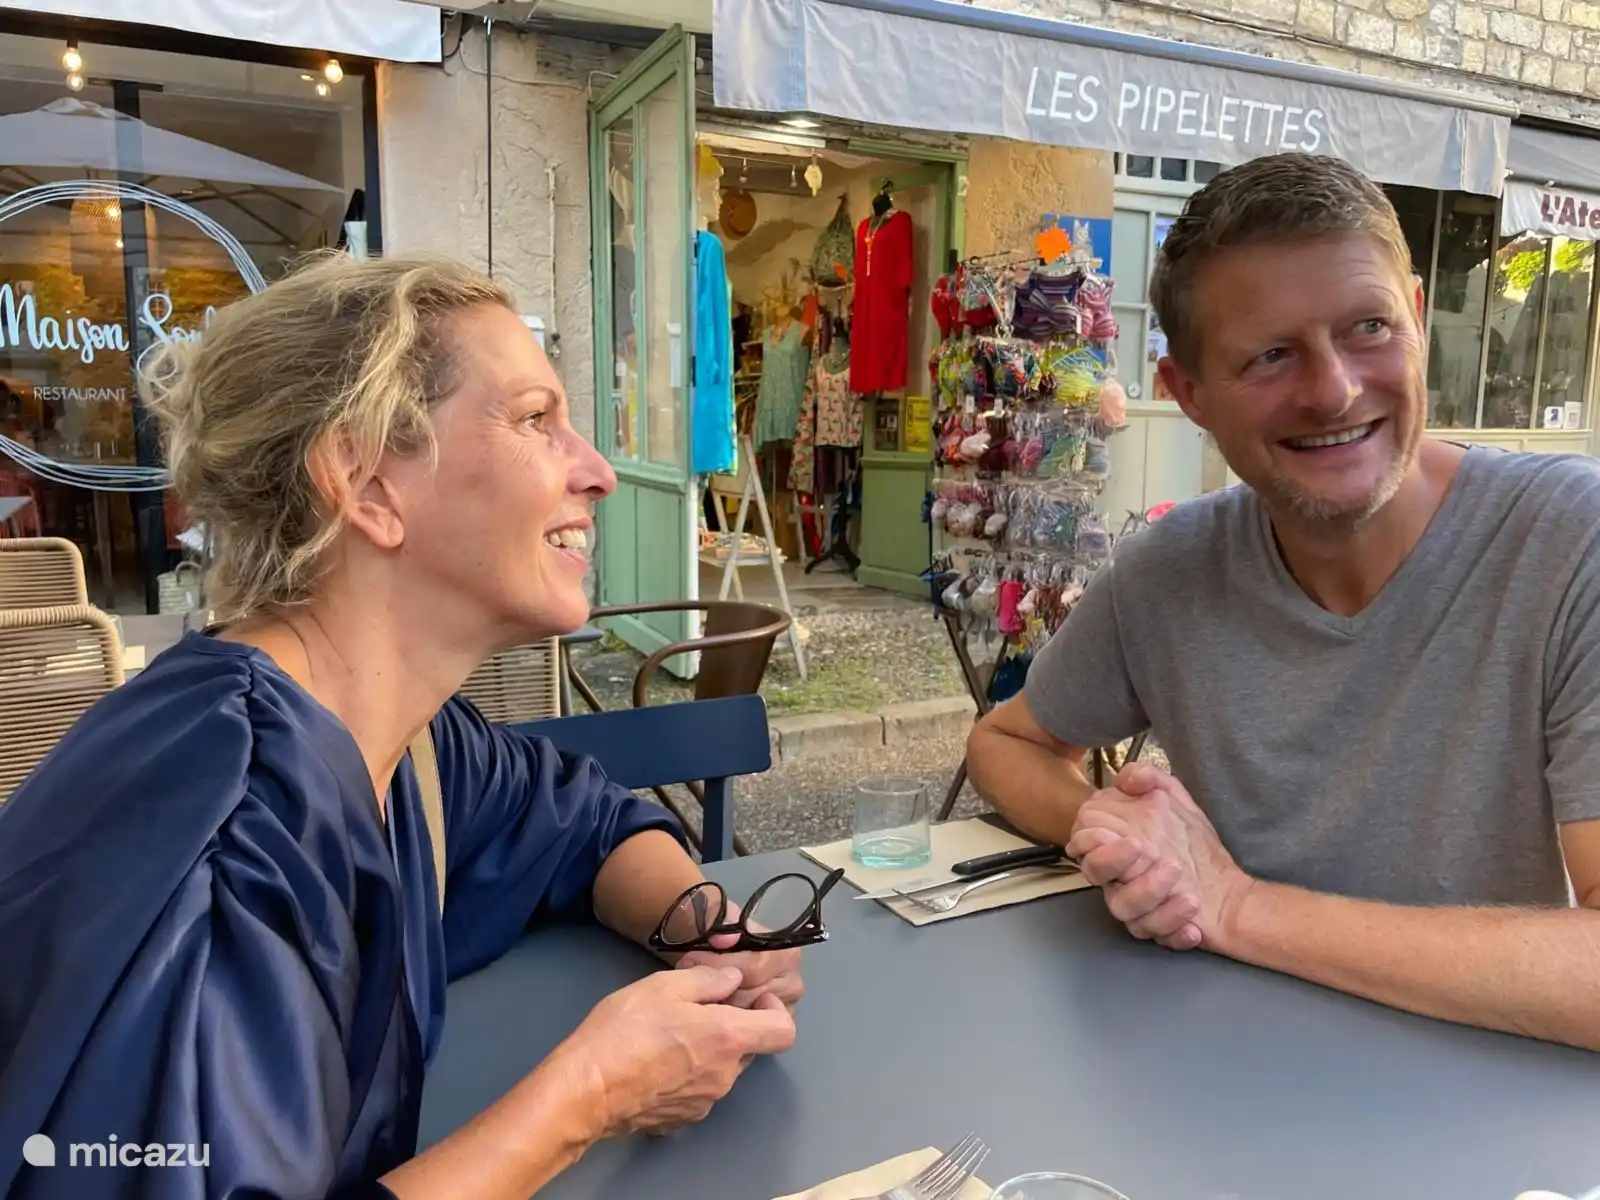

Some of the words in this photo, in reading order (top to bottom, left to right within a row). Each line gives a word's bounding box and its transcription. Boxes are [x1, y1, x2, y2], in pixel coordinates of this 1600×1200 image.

[1025, 67, 1100, 122] LES
[1117, 82, 1324, 152] PIPELETTES
[0, 283, 129, 364] Maison
[33, 386, 126, 402] RESTAURANT
